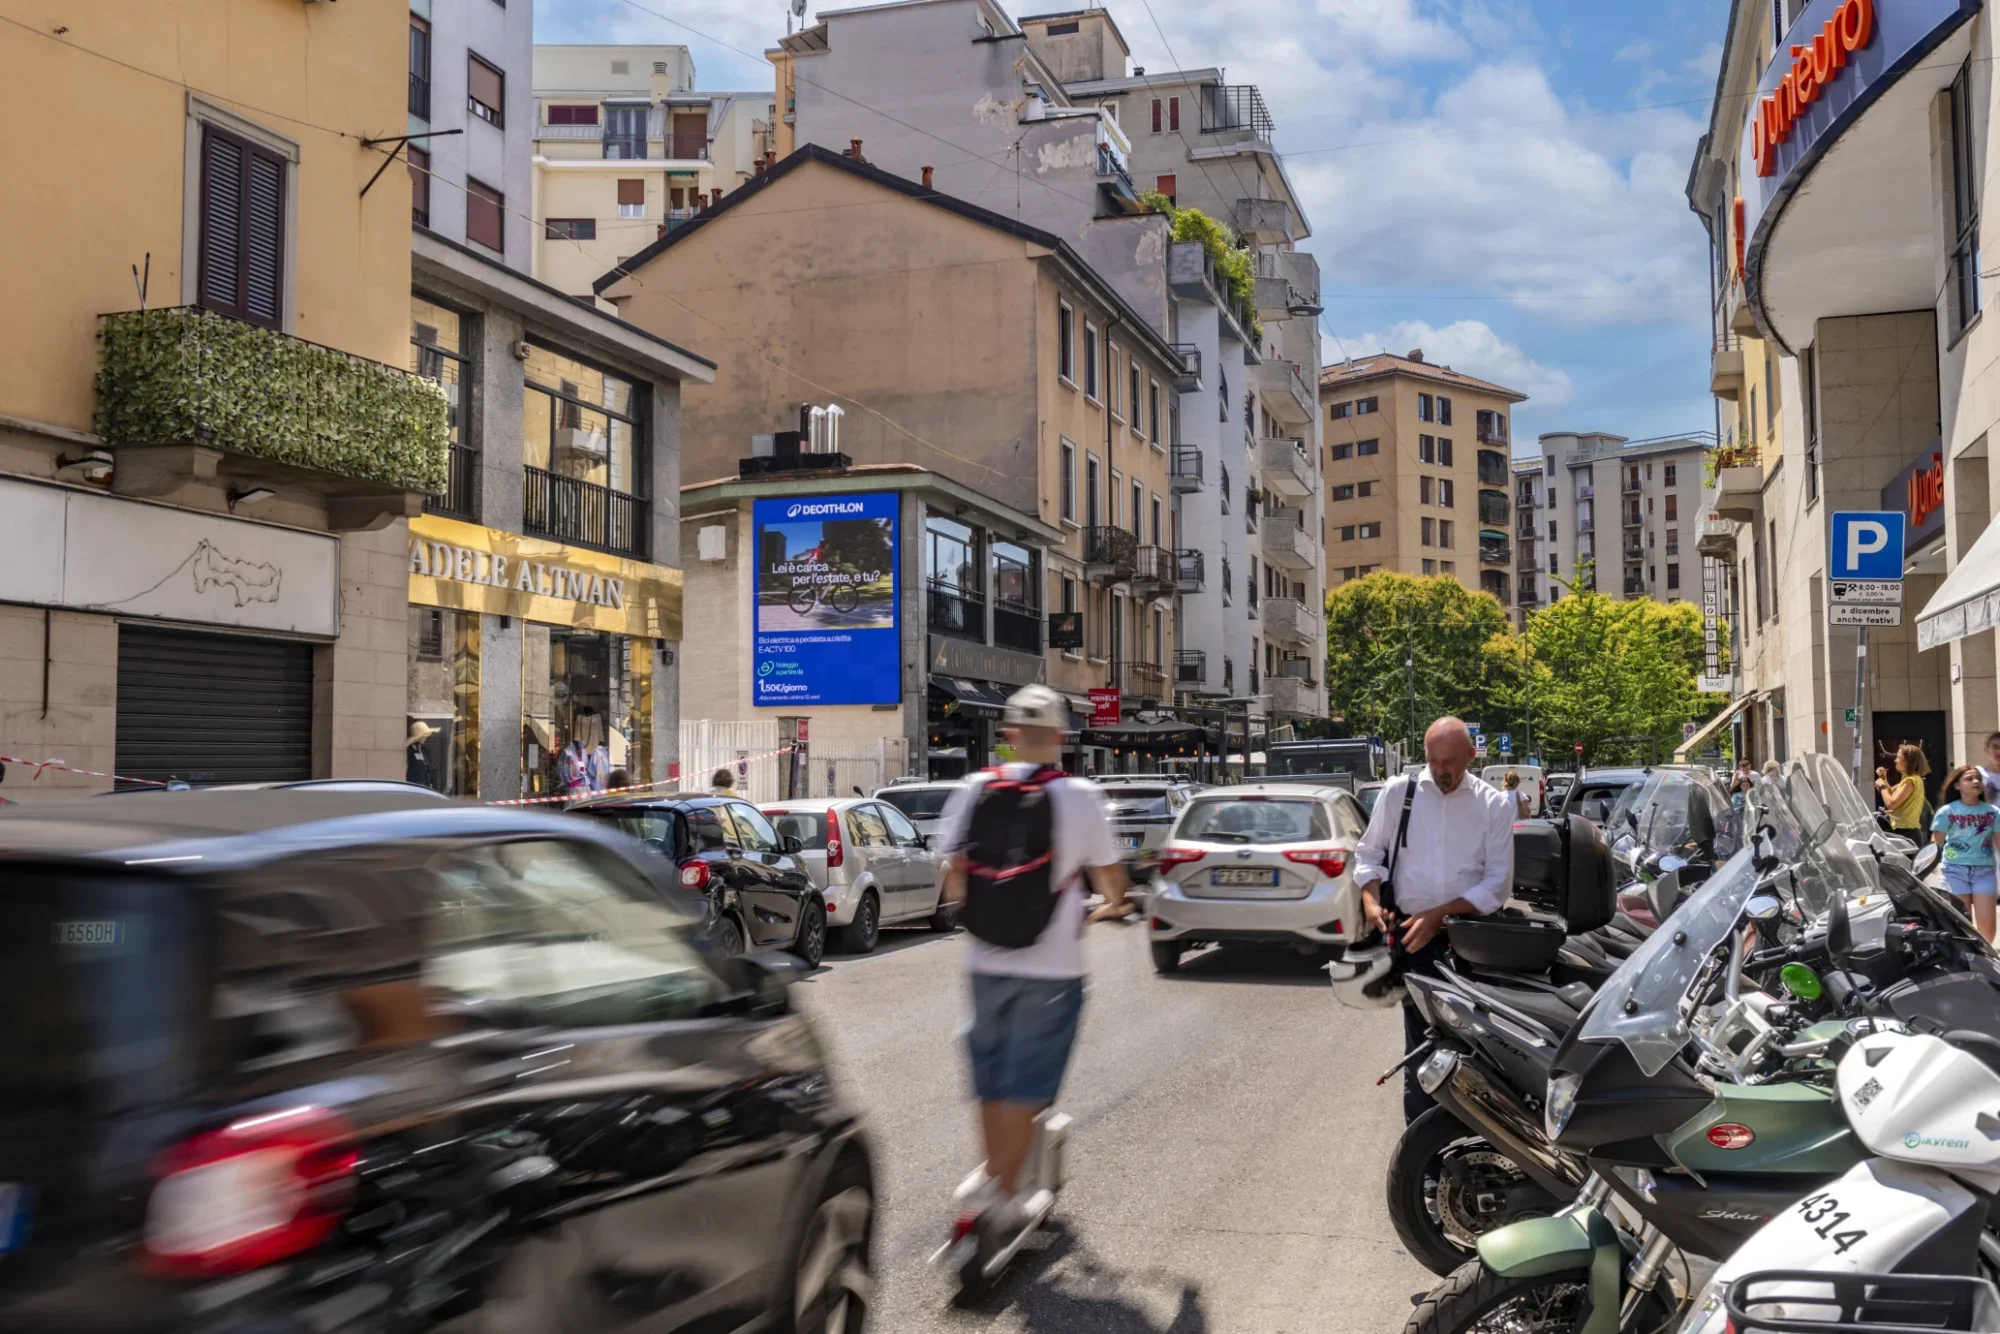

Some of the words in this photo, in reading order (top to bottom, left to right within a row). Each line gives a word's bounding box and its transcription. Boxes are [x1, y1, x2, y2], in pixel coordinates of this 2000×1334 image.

[803, 503, 863, 515] DECATHLON
[1846, 520, 1888, 571] P
[409, 539, 509, 588] ADELE
[514, 560, 624, 609] ALTMAN
[772, 562, 787, 574] Lei
[788, 562, 796, 573] è
[797, 562, 829, 573] carica
[792, 574, 812, 587] per
[854, 574, 862, 582] e
[862, 570, 880, 582] tu?
[1849, 607, 1890, 615] dicembre
[1866, 616, 1894, 624] festivi
[1476, 735, 1485, 748] P
[1502, 736, 1508, 745] P
[1797, 1193, 1868, 1256] 4314
